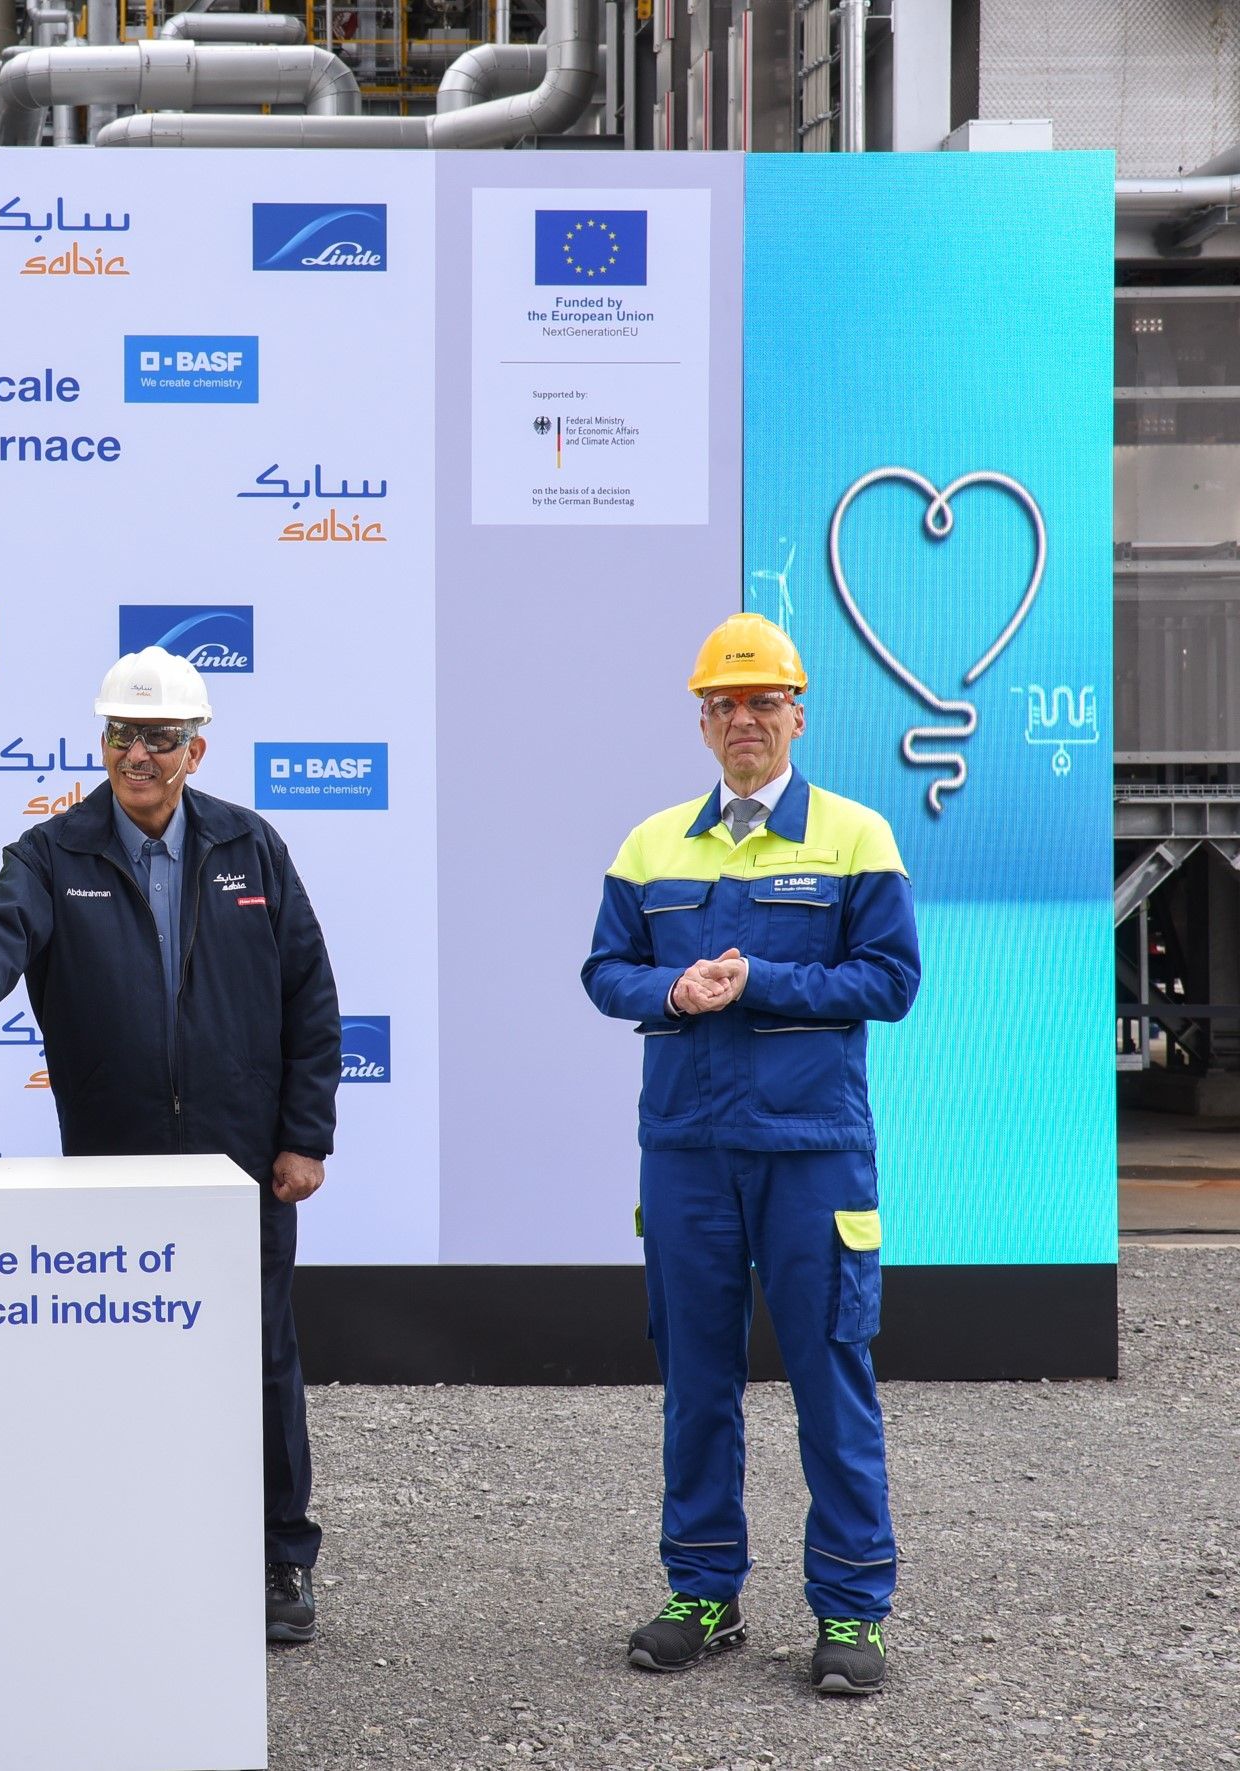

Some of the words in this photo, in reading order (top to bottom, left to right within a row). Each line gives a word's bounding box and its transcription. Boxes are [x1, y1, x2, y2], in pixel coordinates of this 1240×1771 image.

[20, 241, 130, 275] sabic
[302, 242, 380, 265] Linde
[555, 296, 604, 308] Funded
[607, 296, 623, 311] by
[527, 310, 548, 322] the
[551, 310, 613, 324] European
[616, 310, 654, 322] Union
[542, 326, 639, 337] NextGenerationEU
[177, 352, 242, 372] BASF
[140, 377, 157, 387] We
[159, 378, 191, 388] create
[192, 377, 243, 390] chemistry
[532, 390, 574, 400] Supported
[575, 390, 589, 400] by:
[565, 416, 593, 425] Federal
[594, 416, 625, 427] Ministry
[565, 426, 577, 435] for
[578, 426, 614, 435] Economic
[615, 426, 640, 435] Affairs
[565, 437, 580, 446] and
[581, 436, 610, 446] Climate
[610, 436, 635, 446] Action
[545, 487, 558, 495] the
[559, 487, 579, 495] basis
[580, 487, 590, 495] of
[597, 487, 631, 495] decision
[532, 497, 542, 507] by
[543, 497, 557, 505] the
[558, 497, 591, 505] German
[593, 497, 635, 507] Bundestag
[278, 506, 387, 541] sabic
[307, 759, 372, 778] BASF
[270, 784, 288, 794] We
[289, 785, 321, 795] create
[322, 784, 372, 797] chemistry
[789, 877, 817, 886] BASF
[66, 888, 112, 898] Abdulrahman
[341, 1053, 385, 1078] nde
[31, 1245, 127, 1274] heart
[139, 1243, 175, 1273] of
[52, 1294, 201, 1329] industry
